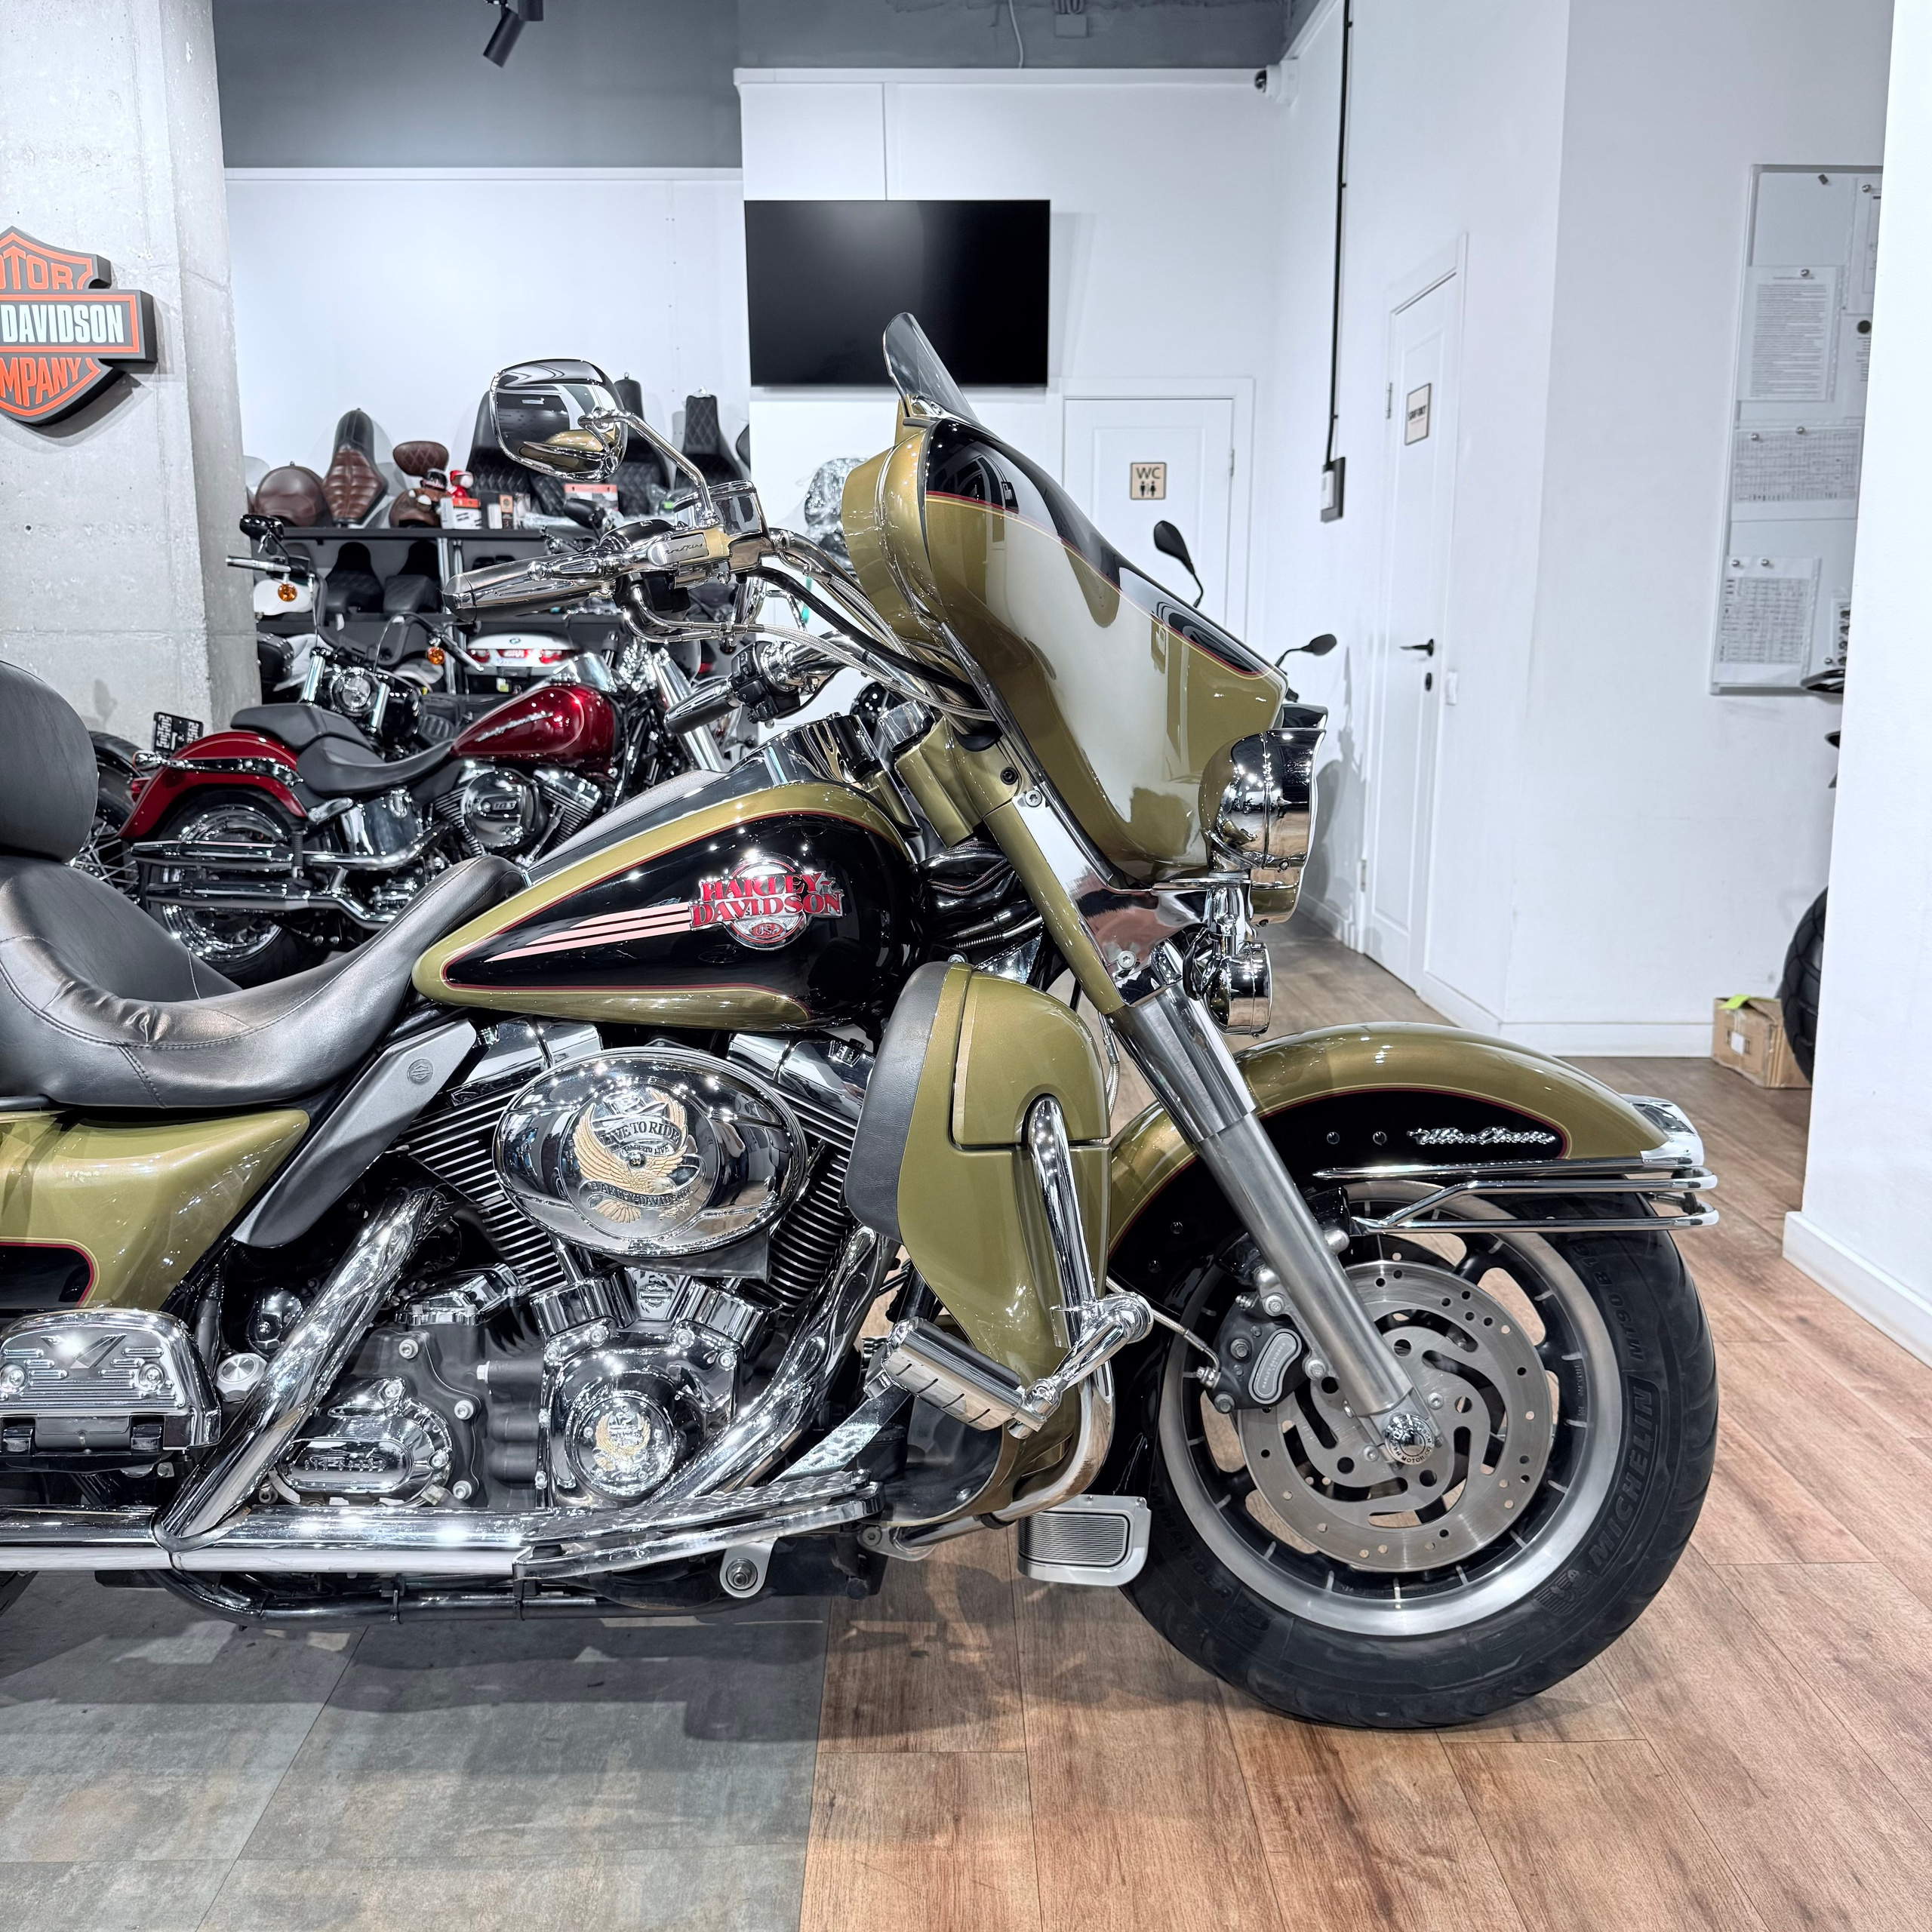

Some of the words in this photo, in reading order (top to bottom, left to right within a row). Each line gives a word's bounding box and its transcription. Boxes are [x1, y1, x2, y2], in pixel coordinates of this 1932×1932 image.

[2, 304, 124, 343] DAVIDSON
[1136, 467, 1161, 479] WC
[691, 893, 843, 928] DAVIDSON
[600, 1124, 632, 1146] LIVE
[630, 1121, 648, 1134] TO
[649, 1121, 681, 1144] RIDE
[654, 1144, 671, 1155] LIVE
[1262, 1343, 1285, 1389] HARLEY-DAVIDSON
[1589, 1386, 1654, 1568] MICHELIN
